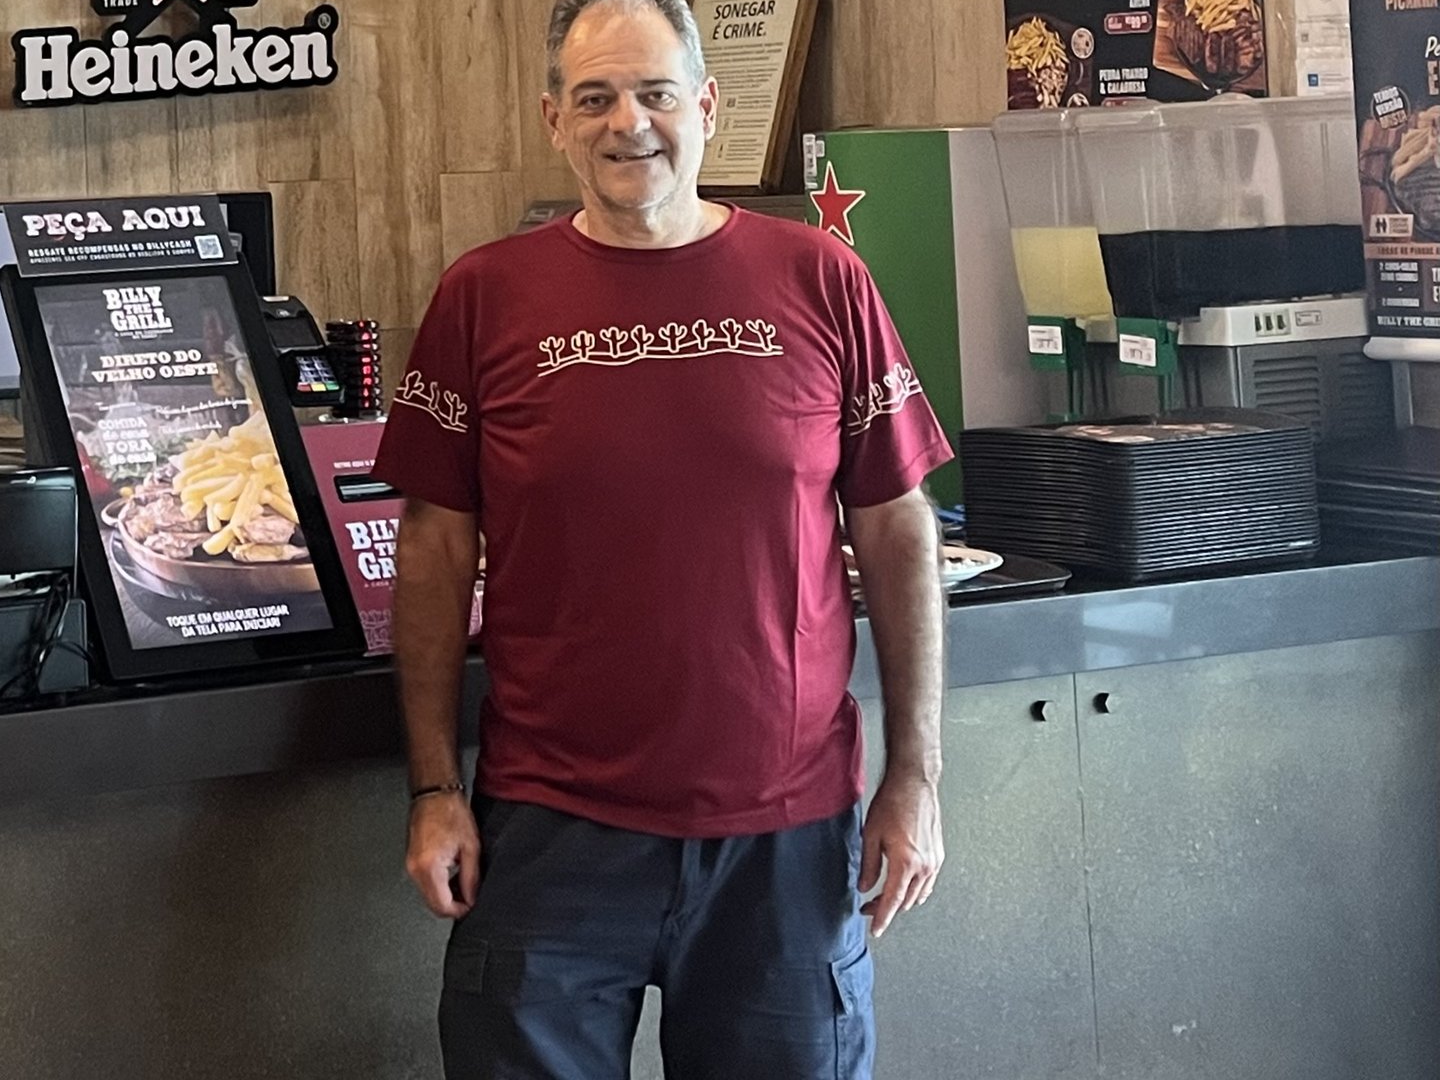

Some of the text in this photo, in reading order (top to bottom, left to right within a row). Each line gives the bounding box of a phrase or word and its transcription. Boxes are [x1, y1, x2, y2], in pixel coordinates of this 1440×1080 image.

[713, 0, 776, 21] SONEGAR
[712, 21, 767, 40] É CRIME.
[20, 24, 333, 101] Heineken
[22, 205, 207, 241] PEÇA AQUI
[28, 247, 65, 257] RESGATE
[67, 243, 130, 255] RECOMPENSAS
[131, 243, 144, 251] NO
[102, 286, 162, 310] BILLY
[123, 303, 153, 315] THE
[110, 308, 173, 331] GRILL
[100, 349, 201, 368] DIRETO DO
[91, 362, 219, 382] VELHO OESTE
[98, 416, 147, 430] COMIDA
[106, 438, 153, 454] FORA
[166, 604, 290, 627] TOQUE EM QUALQUER LUGAR
[181, 626, 196, 638] DA
[196, 623, 218, 636] TELA
[218, 621, 243, 633] PARA
